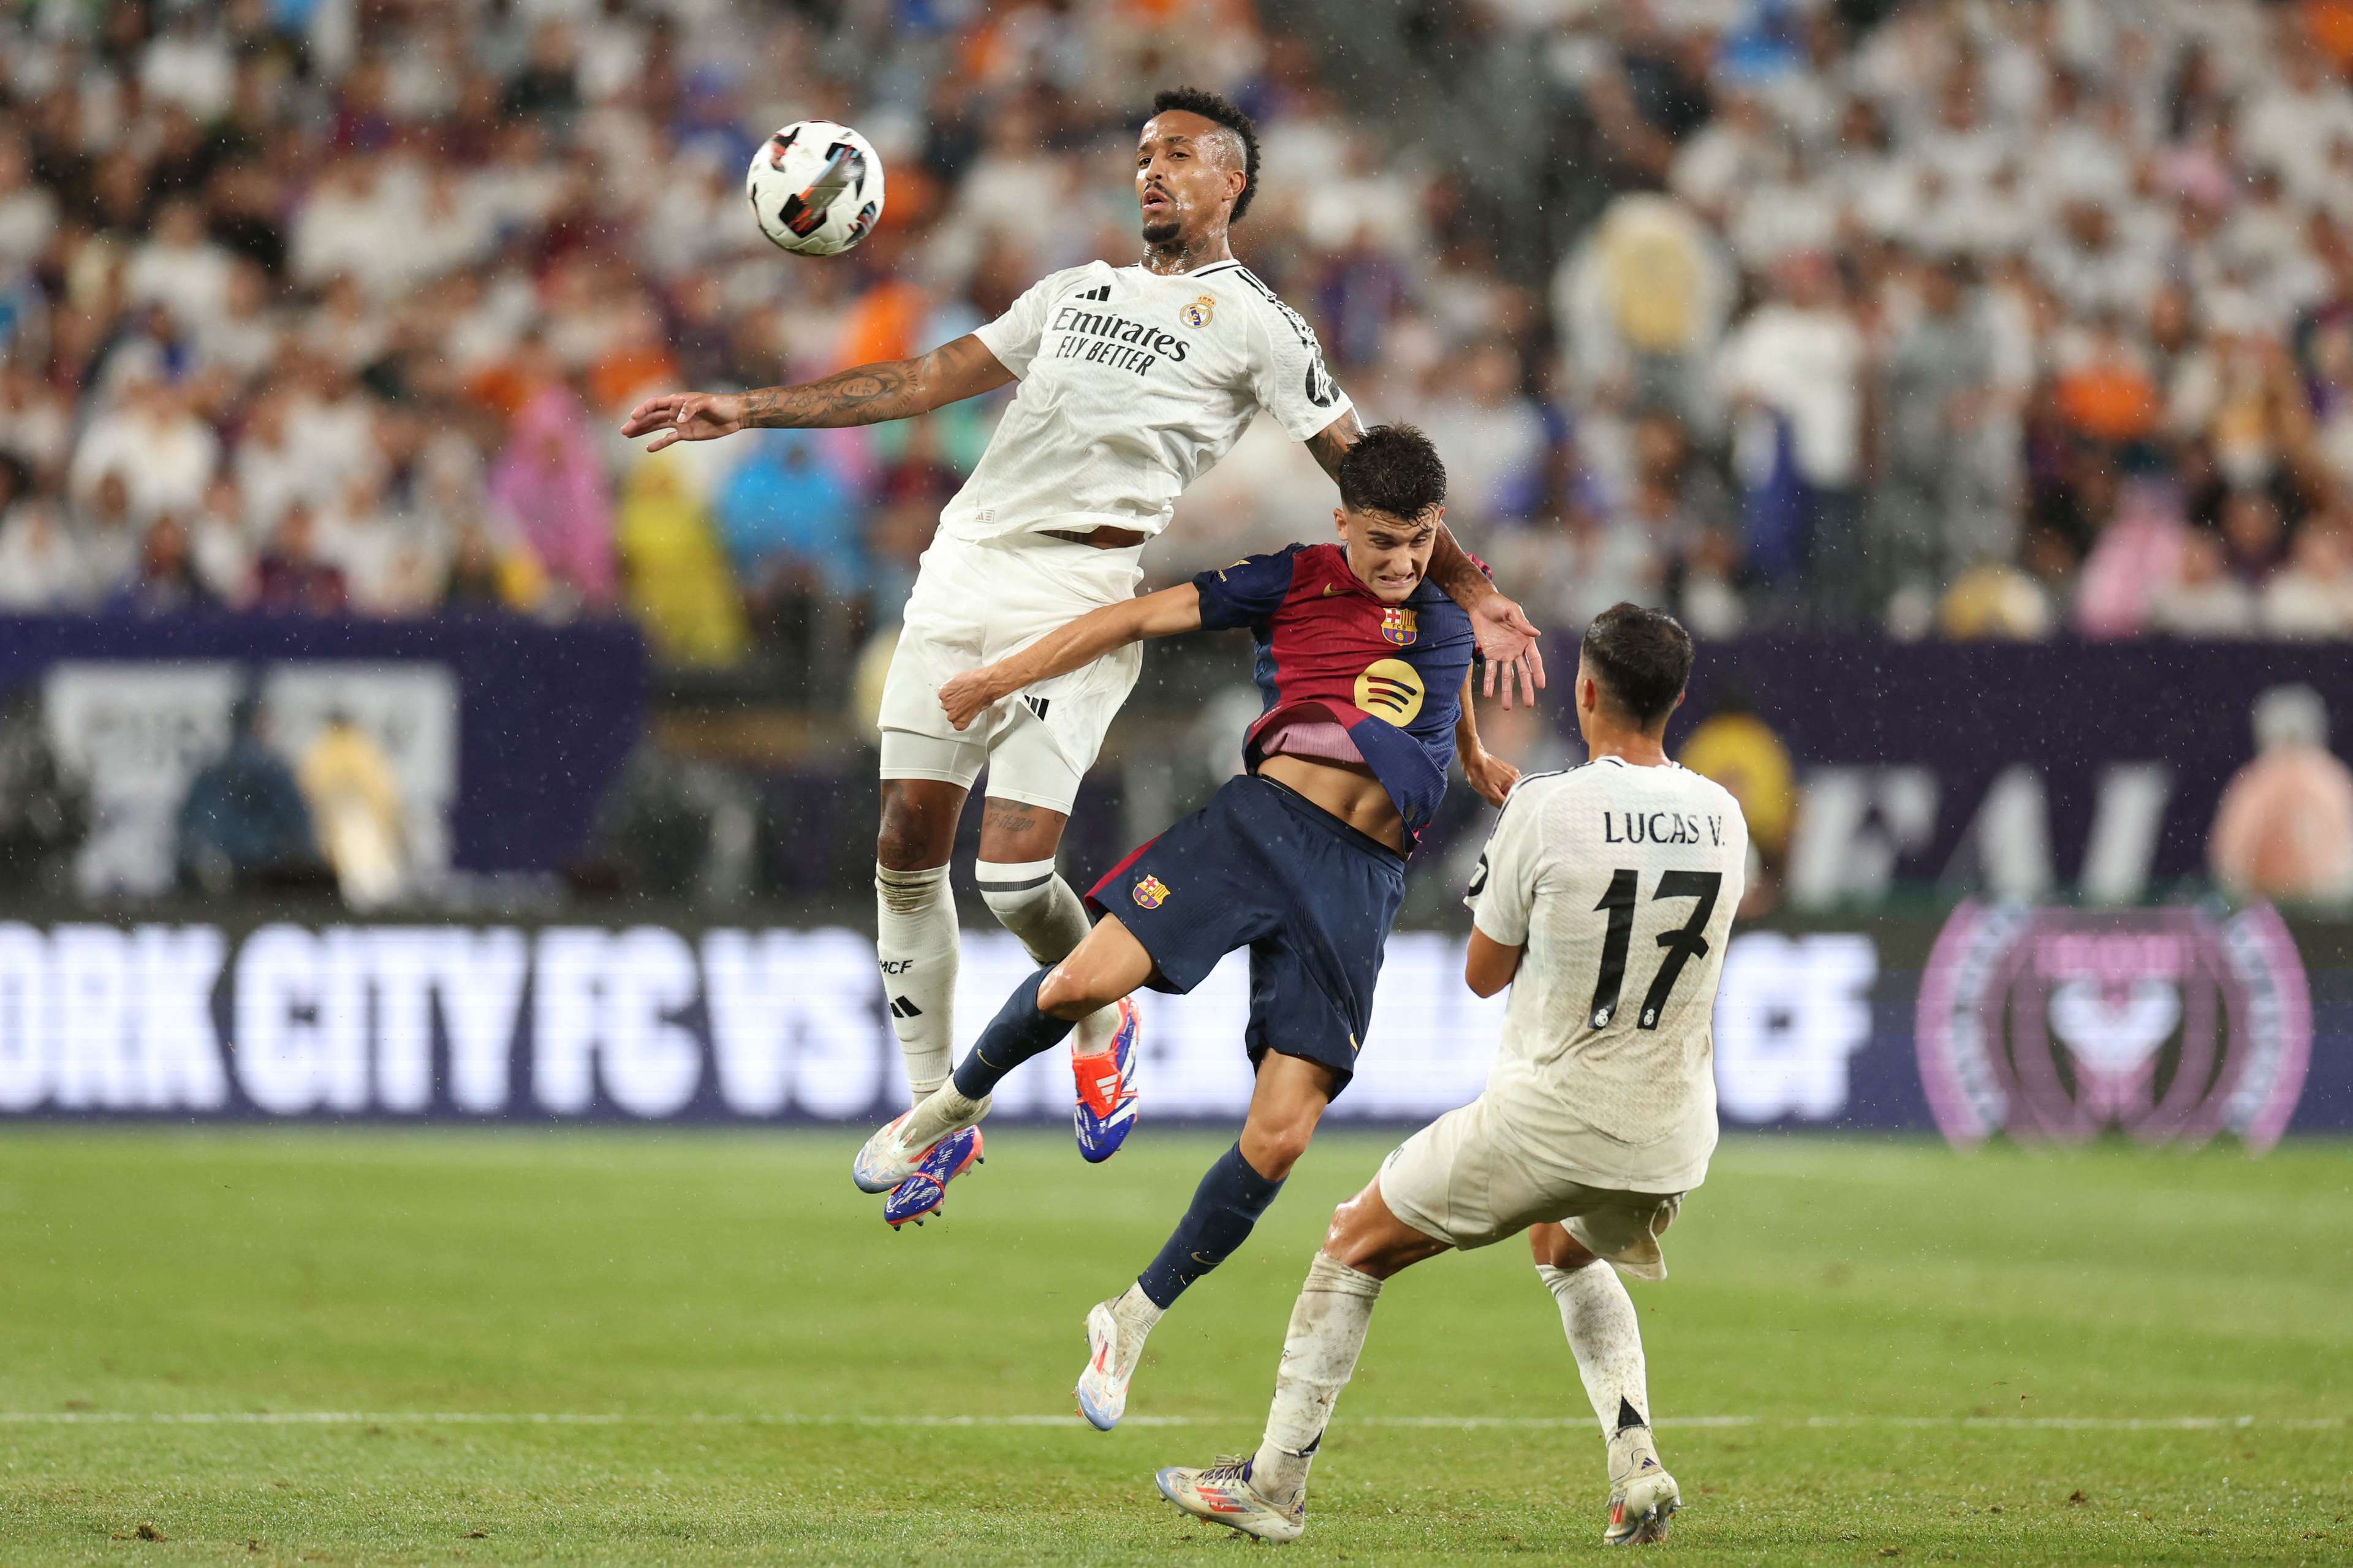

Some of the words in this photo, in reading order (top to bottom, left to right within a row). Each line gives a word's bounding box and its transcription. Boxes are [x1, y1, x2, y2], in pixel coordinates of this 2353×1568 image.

[1051, 307, 1190, 362] Emirates
[1056, 336, 1089, 358] FLY
[1085, 341, 1156, 376] BETTER
[1604, 812, 1699, 844] LUCAS
[1708, 816, 1725, 846] V.
[1588, 869, 1722, 1031] 17
[237, 925, 528, 1112] CITY
[532, 926, 701, 1113] FC
